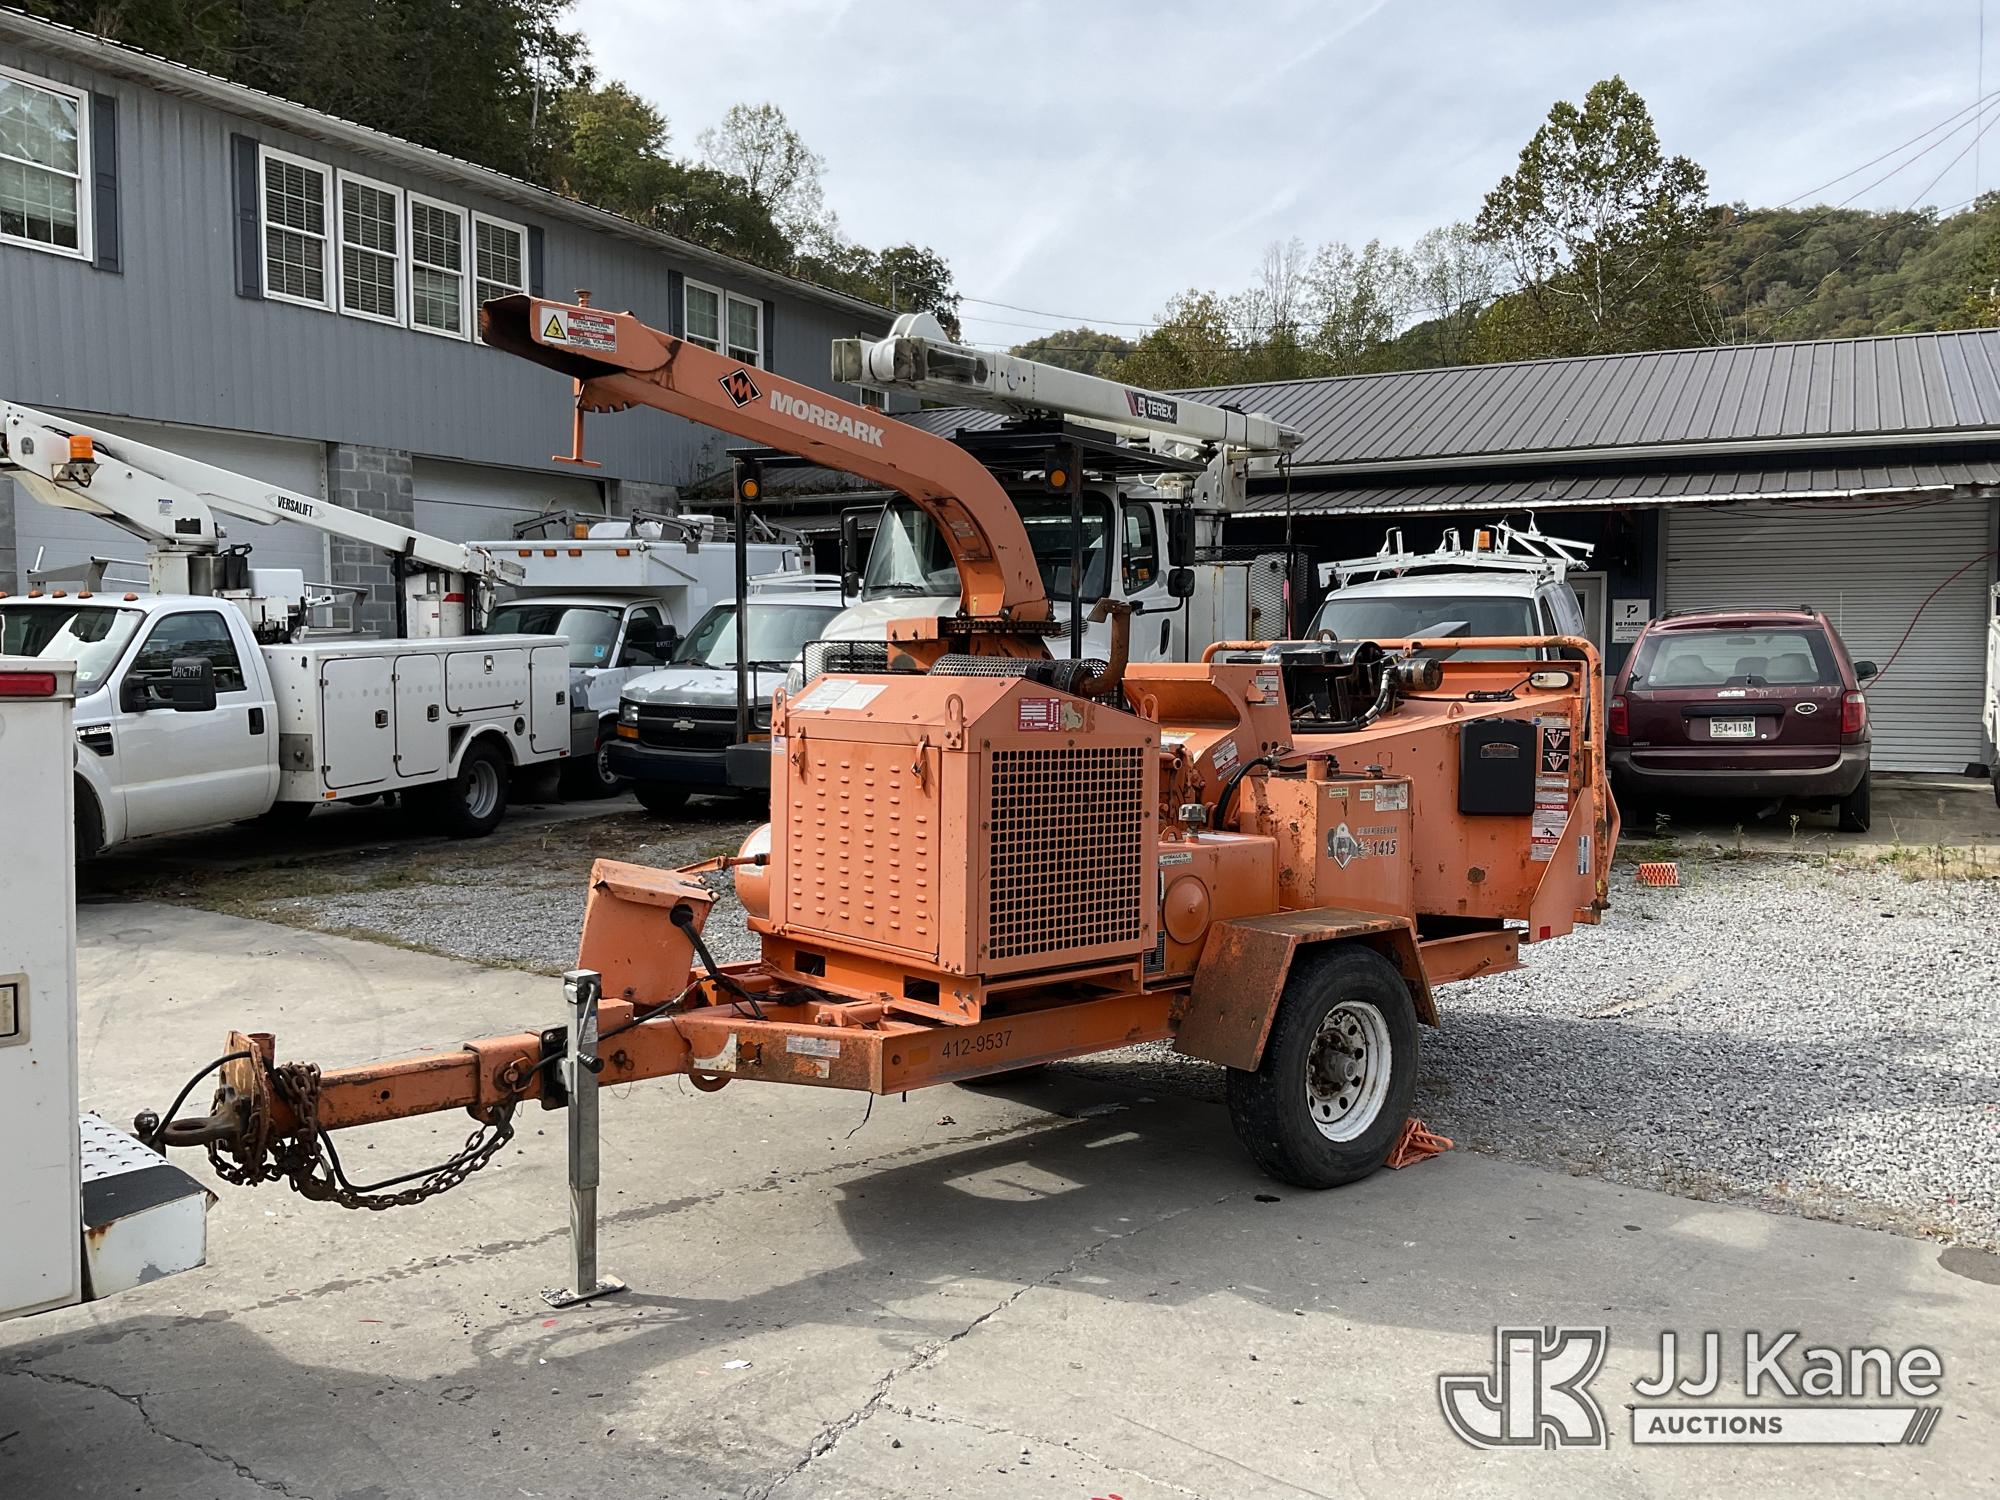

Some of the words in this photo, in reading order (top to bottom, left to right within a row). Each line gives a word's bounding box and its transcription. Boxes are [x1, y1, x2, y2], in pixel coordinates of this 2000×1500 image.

[769, 391, 885, 447] MORBARK
[1147, 400, 1172, 419] TEREX
[277, 495, 314, 518] VERSALIFT
[1372, 839, 1398, 856] 1415
[942, 1030, 1013, 1059] 412-9537
